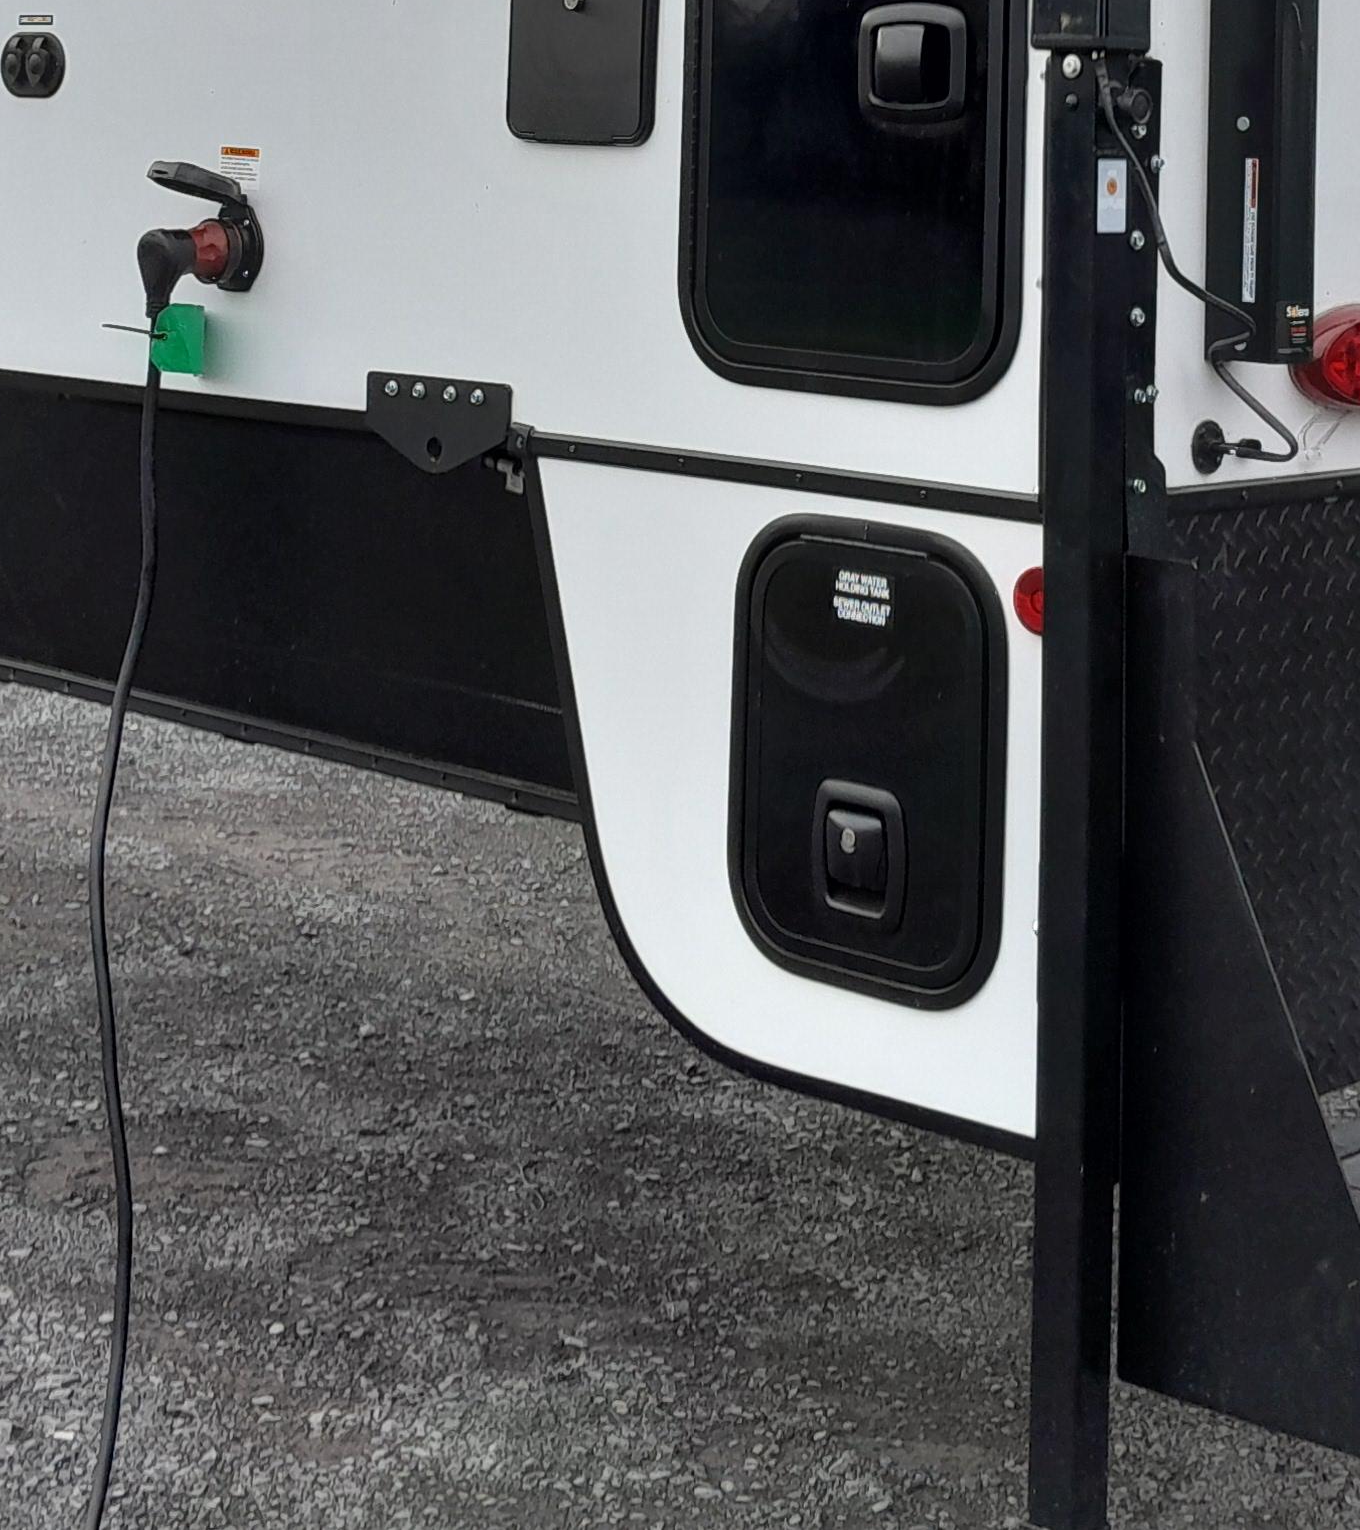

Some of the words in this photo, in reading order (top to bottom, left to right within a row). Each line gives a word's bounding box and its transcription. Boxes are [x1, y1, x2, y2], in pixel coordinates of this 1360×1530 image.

[835, 579, 869, 597] HOLDING
[870, 586, 890, 600] TANK
[861, 573, 888, 589] WATER
